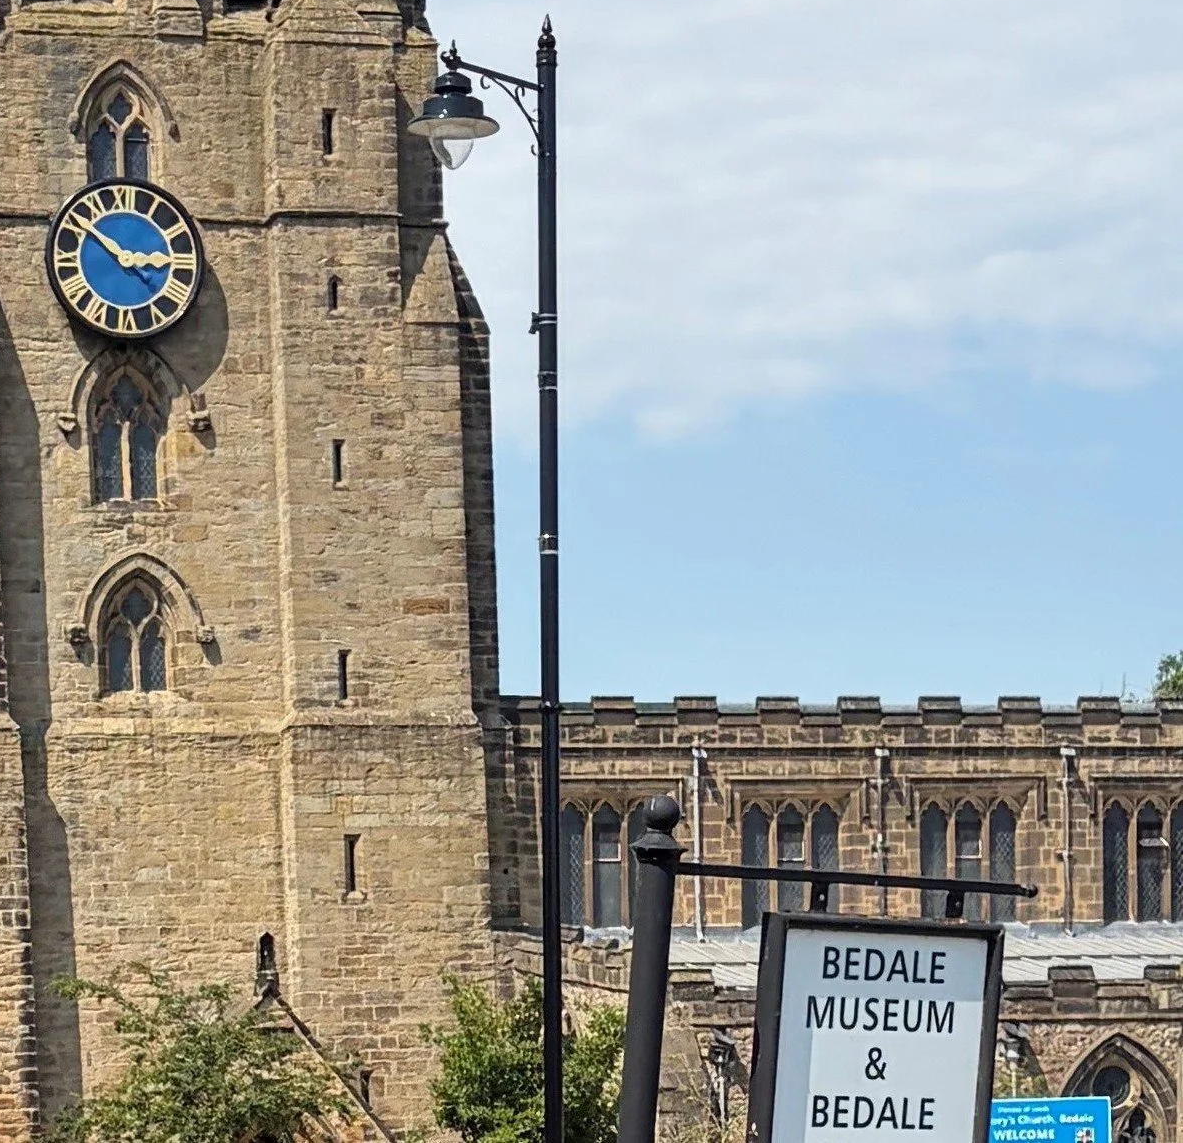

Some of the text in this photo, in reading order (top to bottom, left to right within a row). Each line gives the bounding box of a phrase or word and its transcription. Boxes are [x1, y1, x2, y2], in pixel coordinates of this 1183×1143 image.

[85, 193, 105, 222] XI
[112, 187, 135, 211] XII
[148, 196, 160, 219] I
[165, 222, 186, 239] II
[57, 249, 79, 266] IX
[172, 254, 194, 269] III
[62, 276, 88, 304] VIII
[163, 279, 189, 304] IIII
[84, 296, 107, 325] VII
[118, 309, 137, 332] VI
[150, 303, 167, 325] V
[822, 945, 947, 985] BEDALE
[805, 995, 955, 1034] MUSEUM
[864, 1046, 887, 1081] &
[811, 1094, 935, 1130] BEDALE
[994, 1128, 1055, 1141] WELCOME
